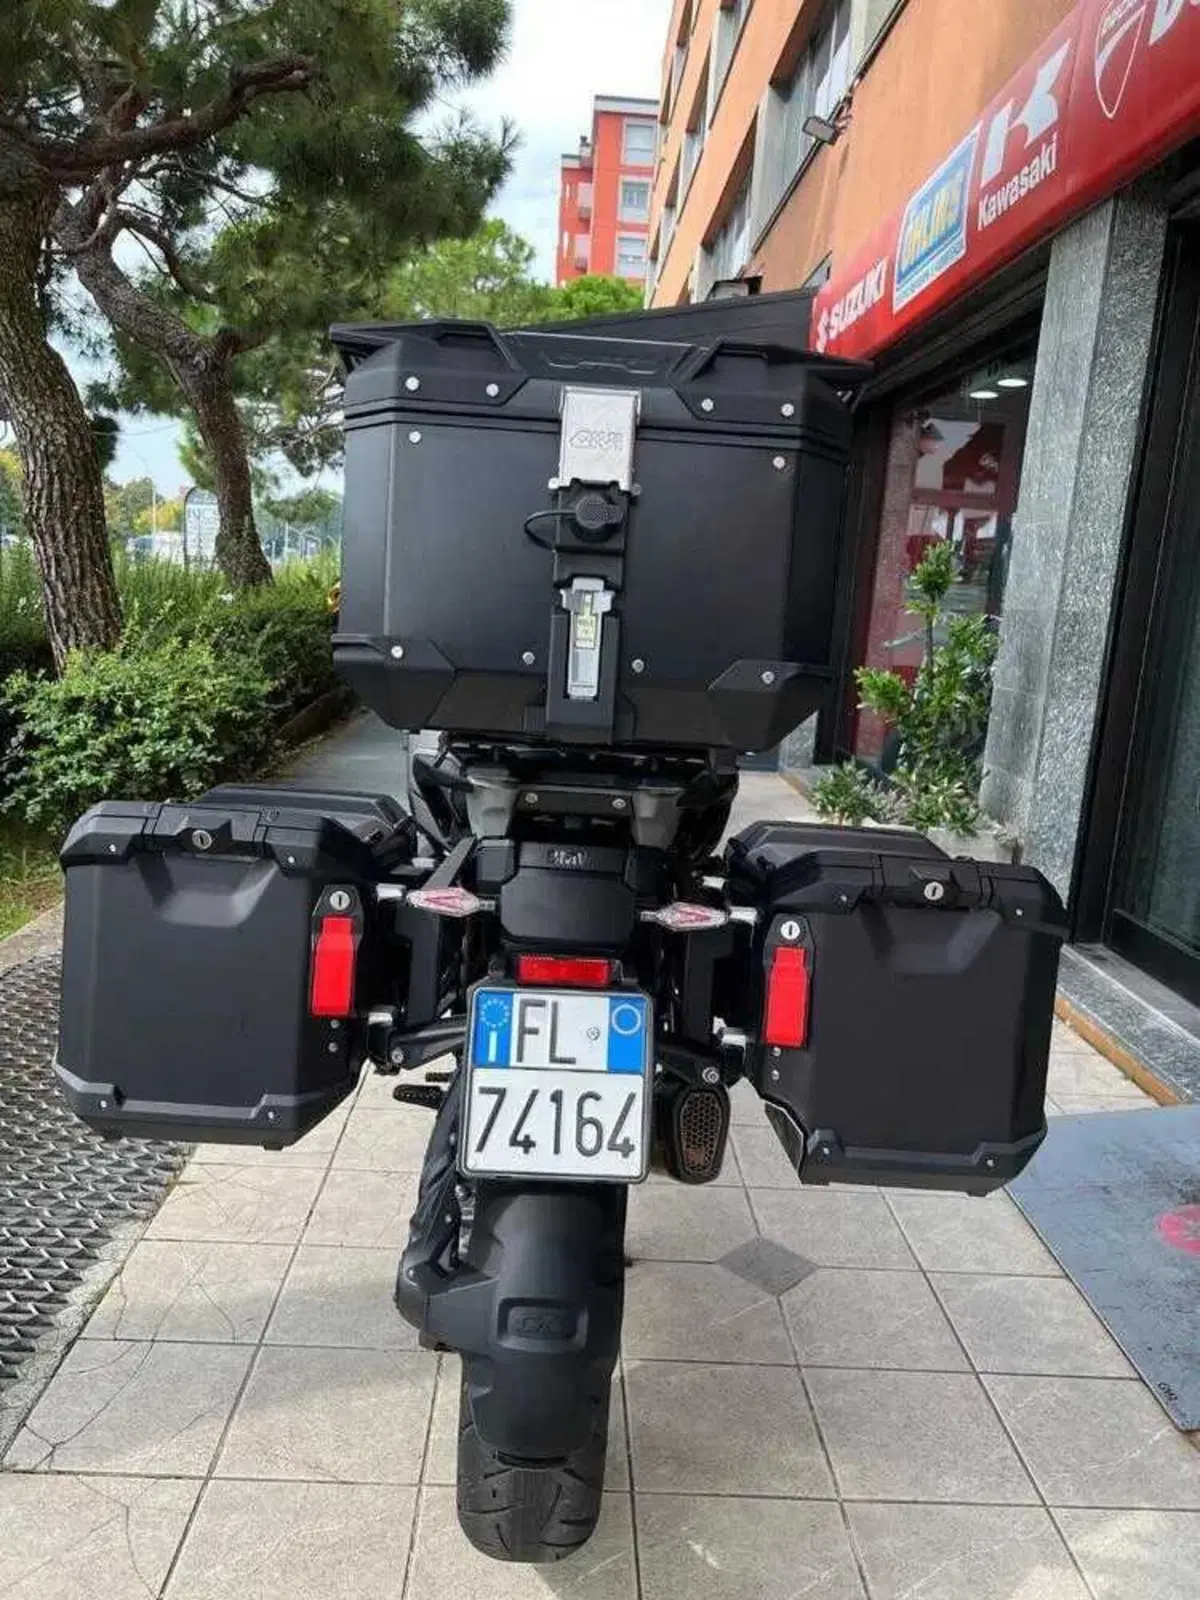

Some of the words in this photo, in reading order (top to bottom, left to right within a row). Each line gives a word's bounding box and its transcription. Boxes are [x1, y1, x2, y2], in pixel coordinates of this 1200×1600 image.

[977, 132, 1058, 231] Kawasaki
[829, 255, 890, 340] SUZUKI
[516, 998, 577, 1065] FL
[475, 1085, 638, 1159] 74164
